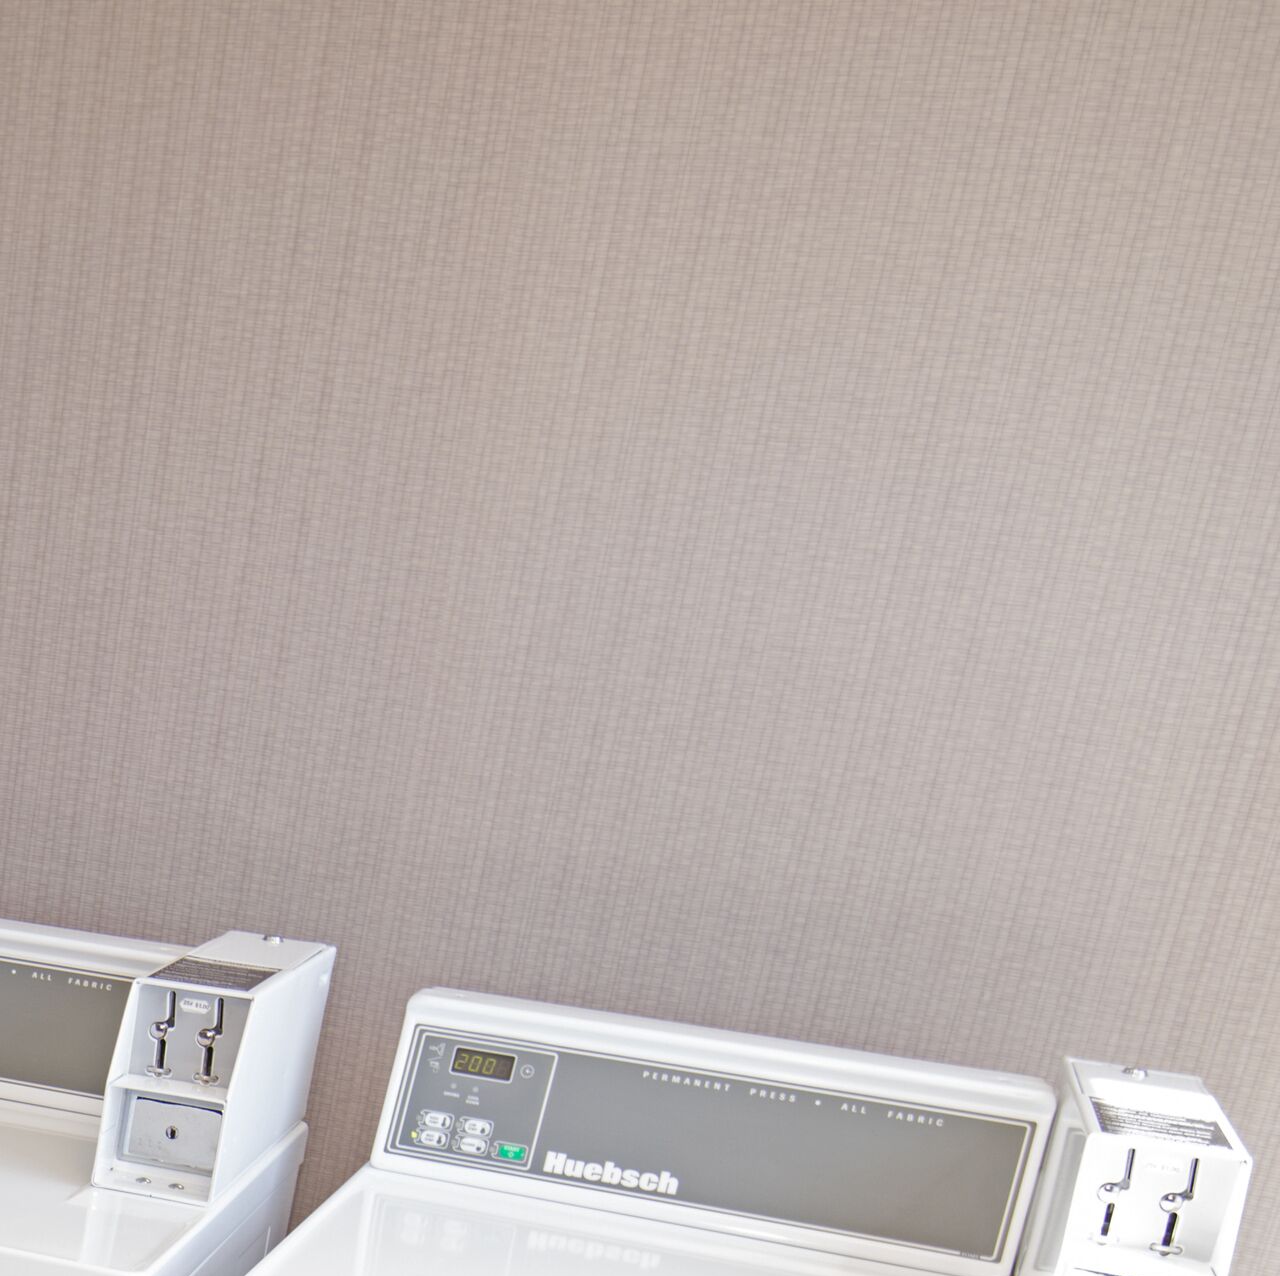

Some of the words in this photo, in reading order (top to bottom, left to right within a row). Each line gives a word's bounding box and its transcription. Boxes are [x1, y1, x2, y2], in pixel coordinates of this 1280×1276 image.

[31, 971, 53, 982] ALL
[67, 976, 113, 992] FABRIC
[454, 1053, 496, 1075] 200
[642, 1070, 731, 1092] PERMANENT
[749, 1087, 797, 1103] PRESS
[840, 1102, 867, 1115] ALL
[887, 1110, 944, 1128] FABRIC
[543, 1150, 679, 1195] Huebsch
